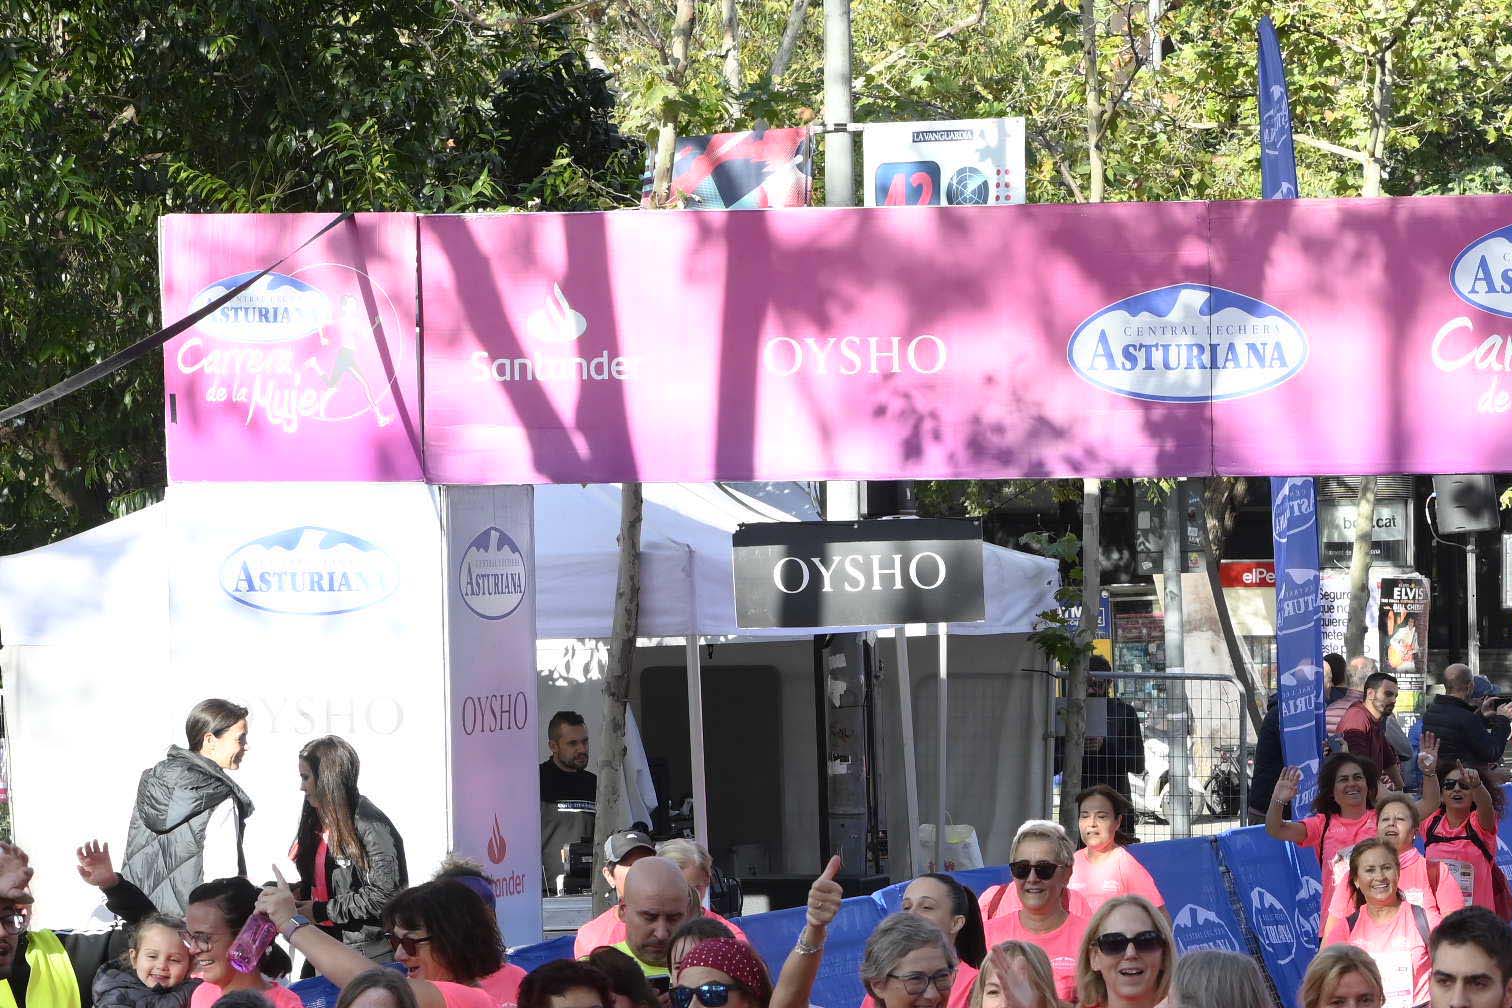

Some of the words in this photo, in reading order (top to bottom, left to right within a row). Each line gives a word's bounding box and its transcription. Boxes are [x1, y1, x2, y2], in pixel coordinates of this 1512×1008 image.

[1123, 324, 1200, 336] CENTRAL
[1206, 322, 1282, 335] LECHERA
[471, 352, 643, 381] Santander
[763, 334, 949, 376] OYSHO
[1087, 328, 1288, 373] ASTURIANA
[1478, 378, 1510, 413] de
[464, 561, 523, 597] ASTURIANA
[772, 551, 947, 594] OYSHO
[461, 691, 528, 736] OYSHO
